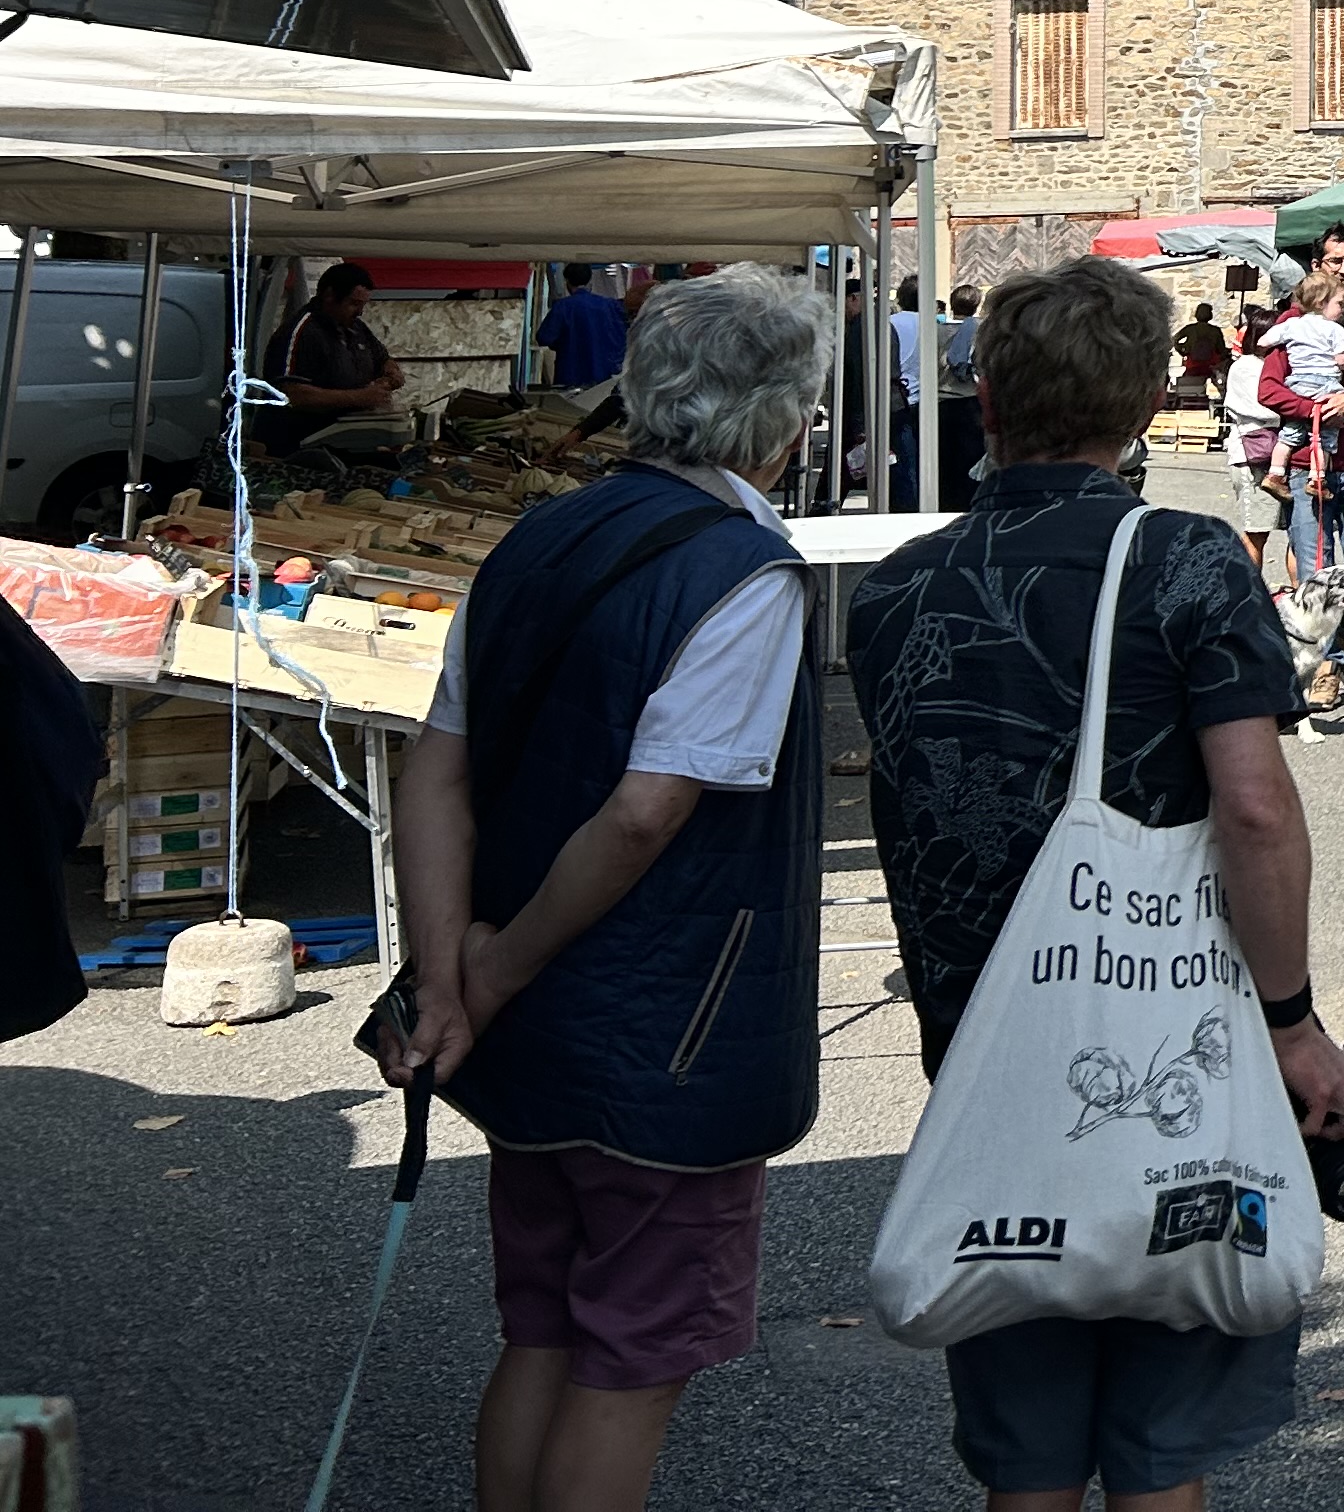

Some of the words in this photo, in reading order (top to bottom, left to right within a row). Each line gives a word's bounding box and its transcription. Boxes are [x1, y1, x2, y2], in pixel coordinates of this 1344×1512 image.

[1070, 861, 1112, 916] Ce
[1126, 890, 1182, 927] sac
[1032, 943, 1078, 985] un
[1094, 935, 1157, 992] bon
[1170, 940, 1251, 998] coton.
[1143, 1166, 1169, 1186] Sac
[1173, 1158, 1210, 1181] 100%
[957, 1216, 1068, 1251] ALDI
